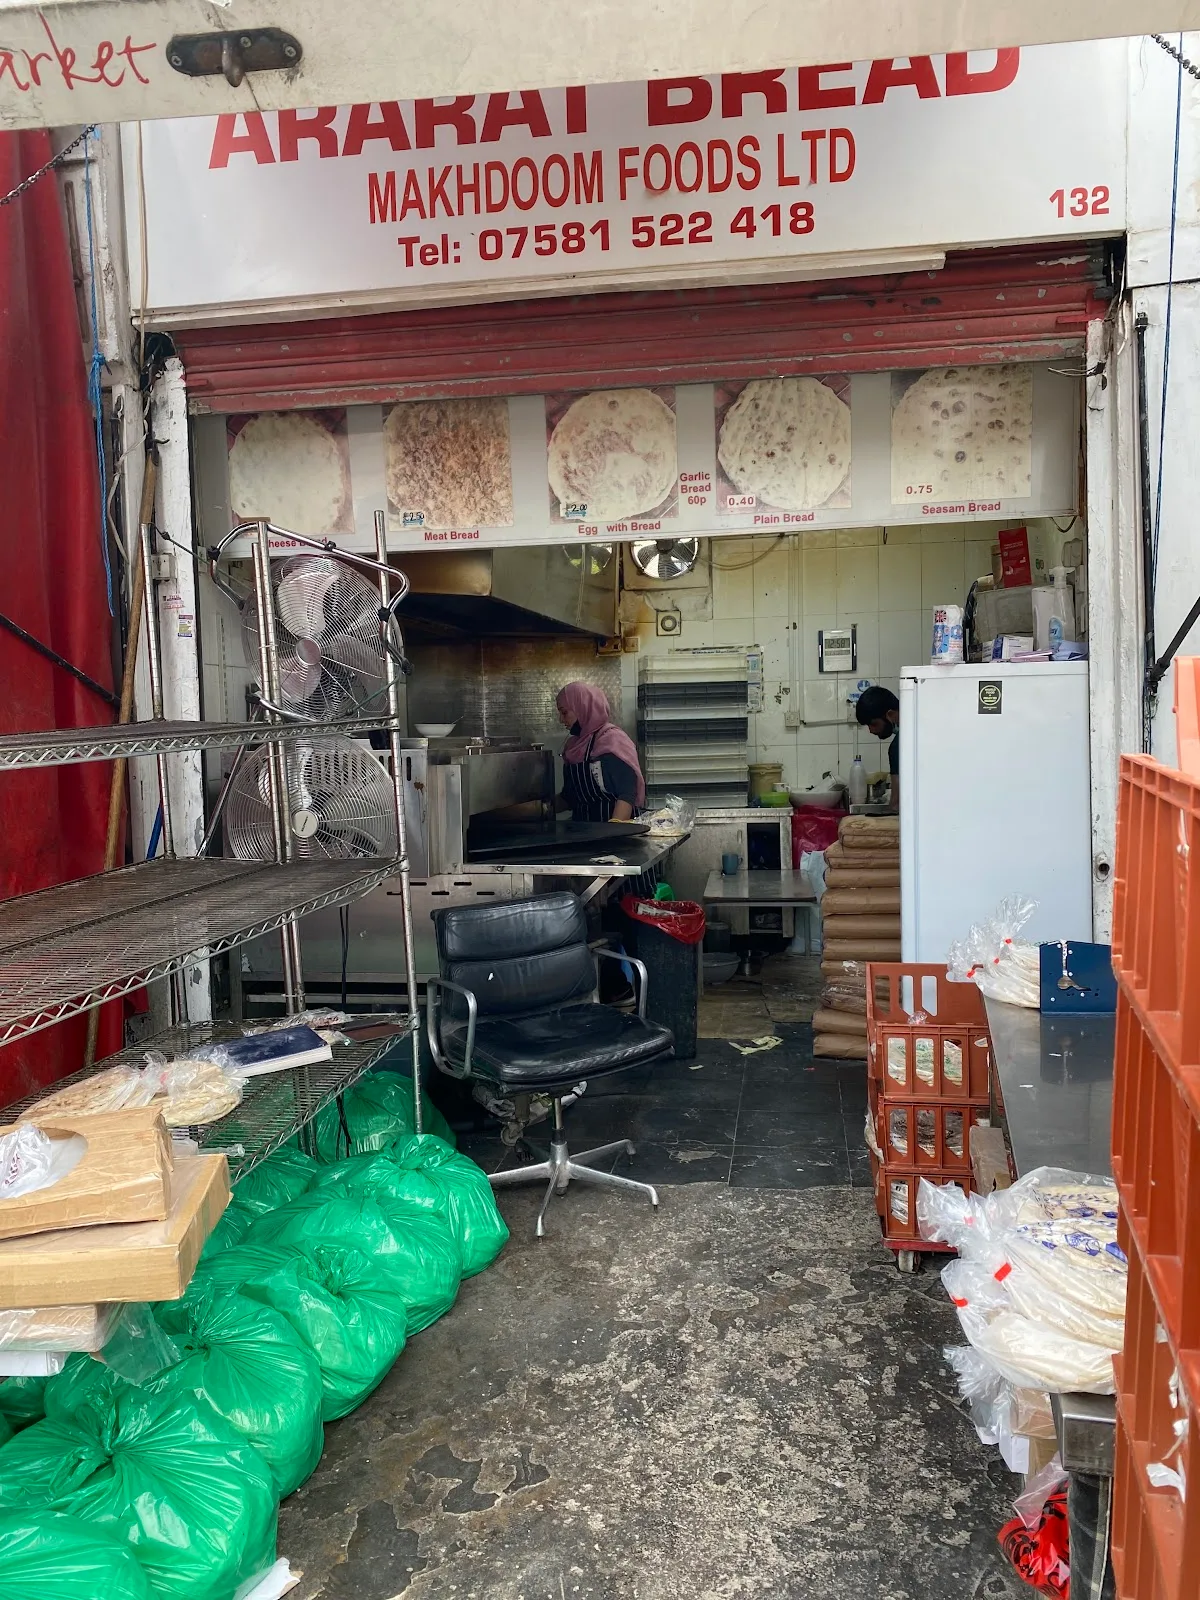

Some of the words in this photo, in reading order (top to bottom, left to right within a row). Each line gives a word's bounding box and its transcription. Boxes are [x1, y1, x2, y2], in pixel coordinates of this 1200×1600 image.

[647, 47, 1020, 126] BREAD
[368, 151, 604, 224] MAKHDOOM
[619, 135, 762, 200] FOODS
[777, 128, 856, 186] LTD
[1049, 186, 1109, 218] 132
[397, 233, 461, 267] Tel:
[479, 219, 610, 261] 07581
[632, 211, 712, 248] 522
[730, 202, 815, 238] 418
[680, 472, 711, 482] Garlic
[680, 483, 711, 493] Bread
[906, 485, 933, 494] 0.75
[687, 495, 707, 506] 60p
[728, 496, 754, 506] 0.40
[922, 505, 965, 515] Seasam
[968, 502, 1001, 512] Bread
[753, 515, 780, 524] Plain
[783, 512, 815, 522] Bread
[578, 525, 598, 535] Egg
[606, 522, 628, 532] with
[631, 521, 661, 531] Bread
[424, 532, 448, 541] Meat
[450, 530, 479, 540] Bread
[268, 539, 297, 548] heese
